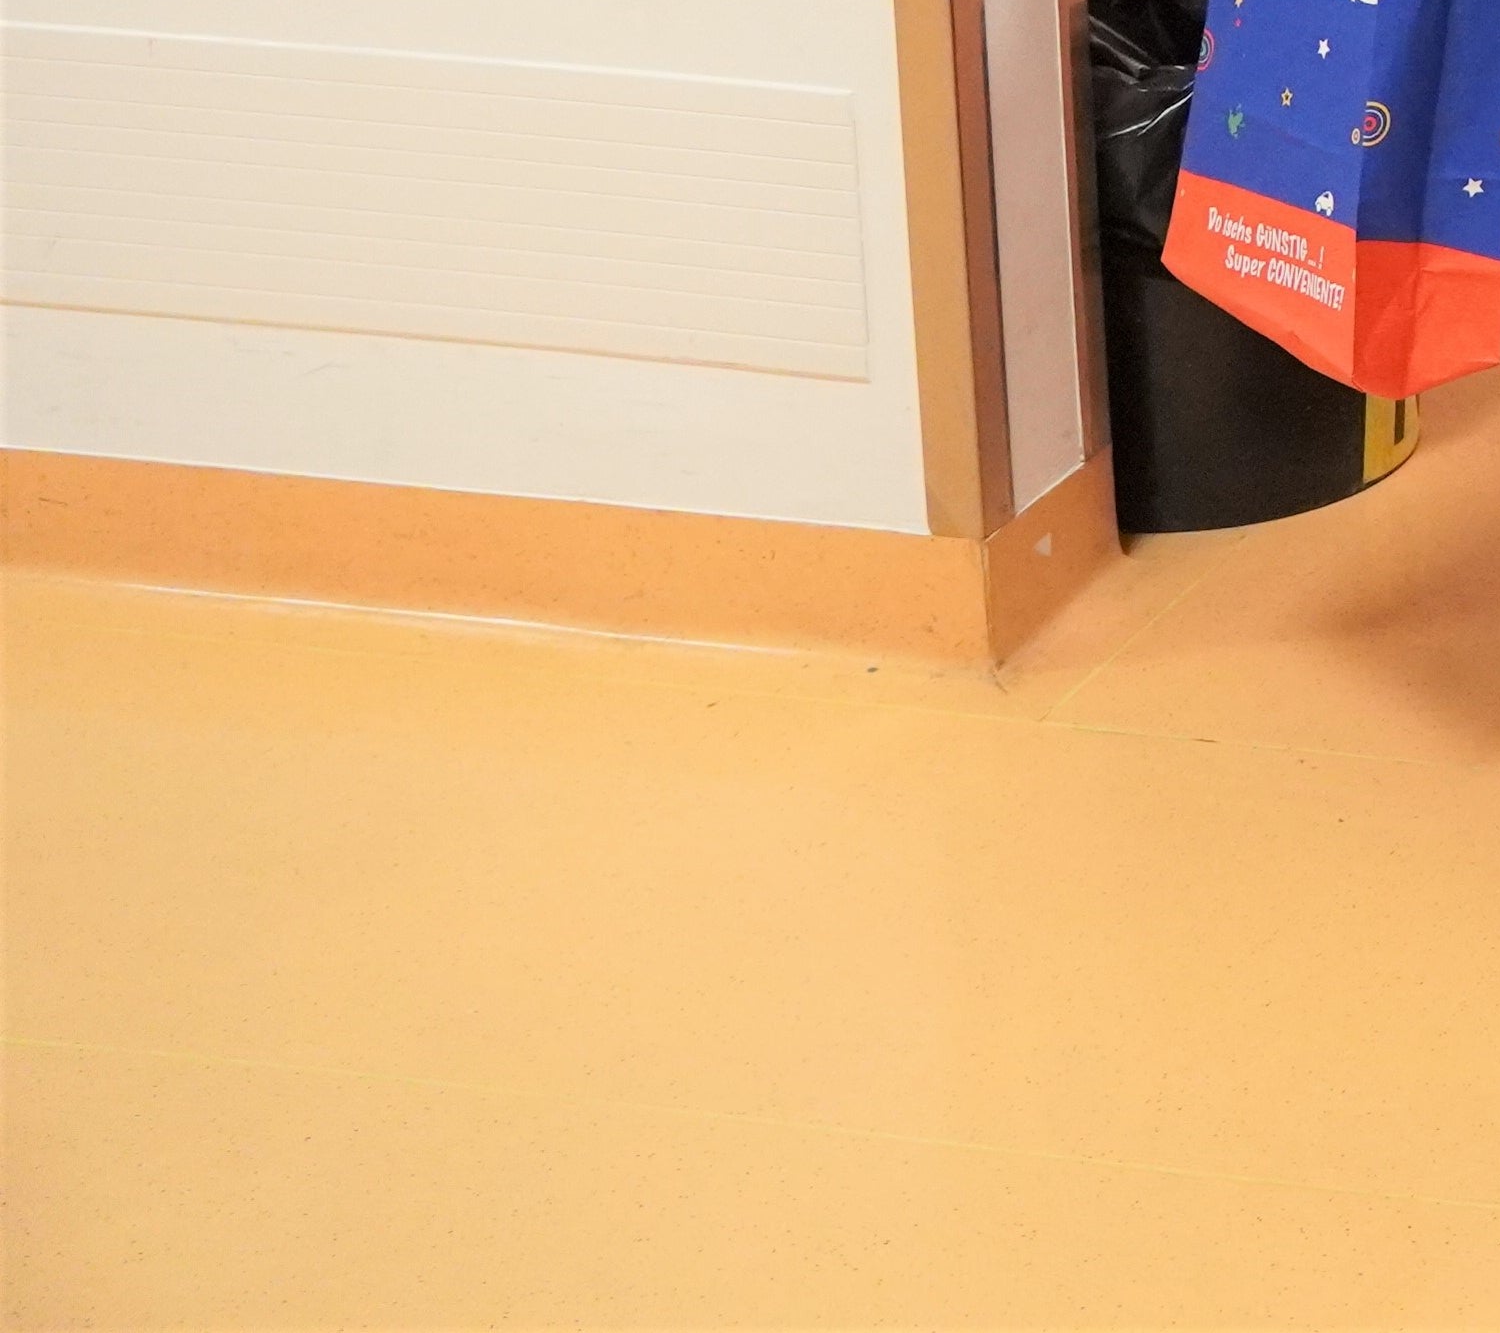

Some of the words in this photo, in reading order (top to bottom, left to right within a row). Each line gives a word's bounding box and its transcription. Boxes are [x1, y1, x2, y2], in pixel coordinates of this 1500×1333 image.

[1207, 206, 1223, 233] Do
[1222, 213, 1253, 245] ischs
[1256, 222, 1308, 262] GÜNSTIG
[1225, 244, 1266, 278] Super
[1267, 257, 1345, 311] CONVENIENTE!
